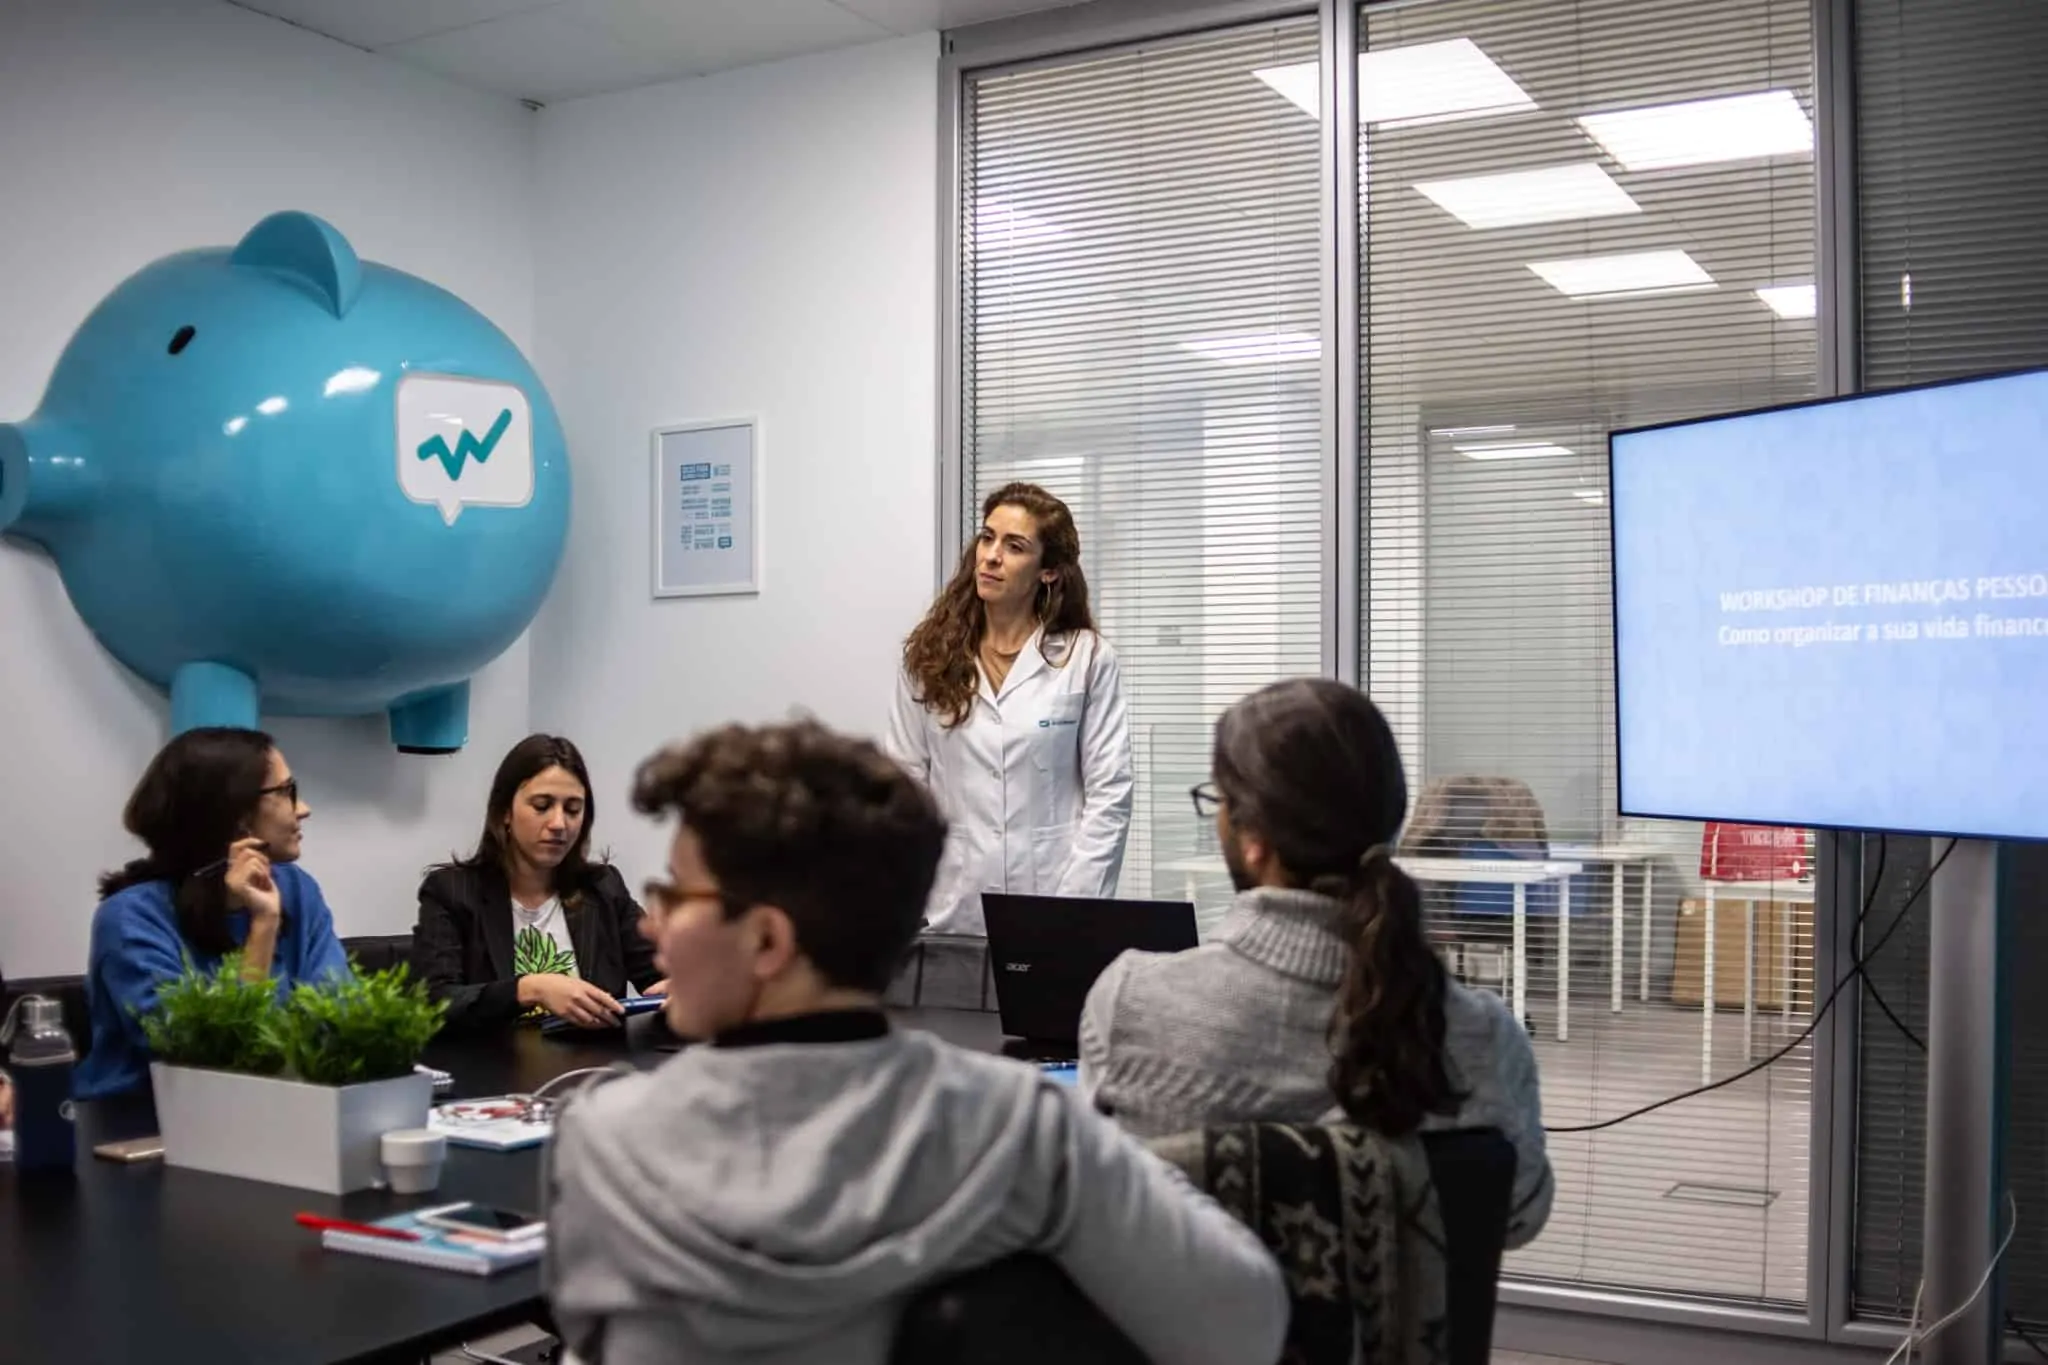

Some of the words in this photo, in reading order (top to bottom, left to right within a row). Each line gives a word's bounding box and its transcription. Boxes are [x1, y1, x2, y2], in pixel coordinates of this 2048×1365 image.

[1720, 586, 1828, 612] WORKSHOP
[1833, 585, 1859, 606] DE
[1864, 578, 1970, 607] FINANÇAS
[1718, 624, 1769, 646] Como
[1774, 620, 1860, 648] organizar
[1867, 624, 1879, 640] a
[1882, 621, 1919, 640] sua
[1924, 615, 1969, 638] vida
[1005, 962, 1031, 972] acer
